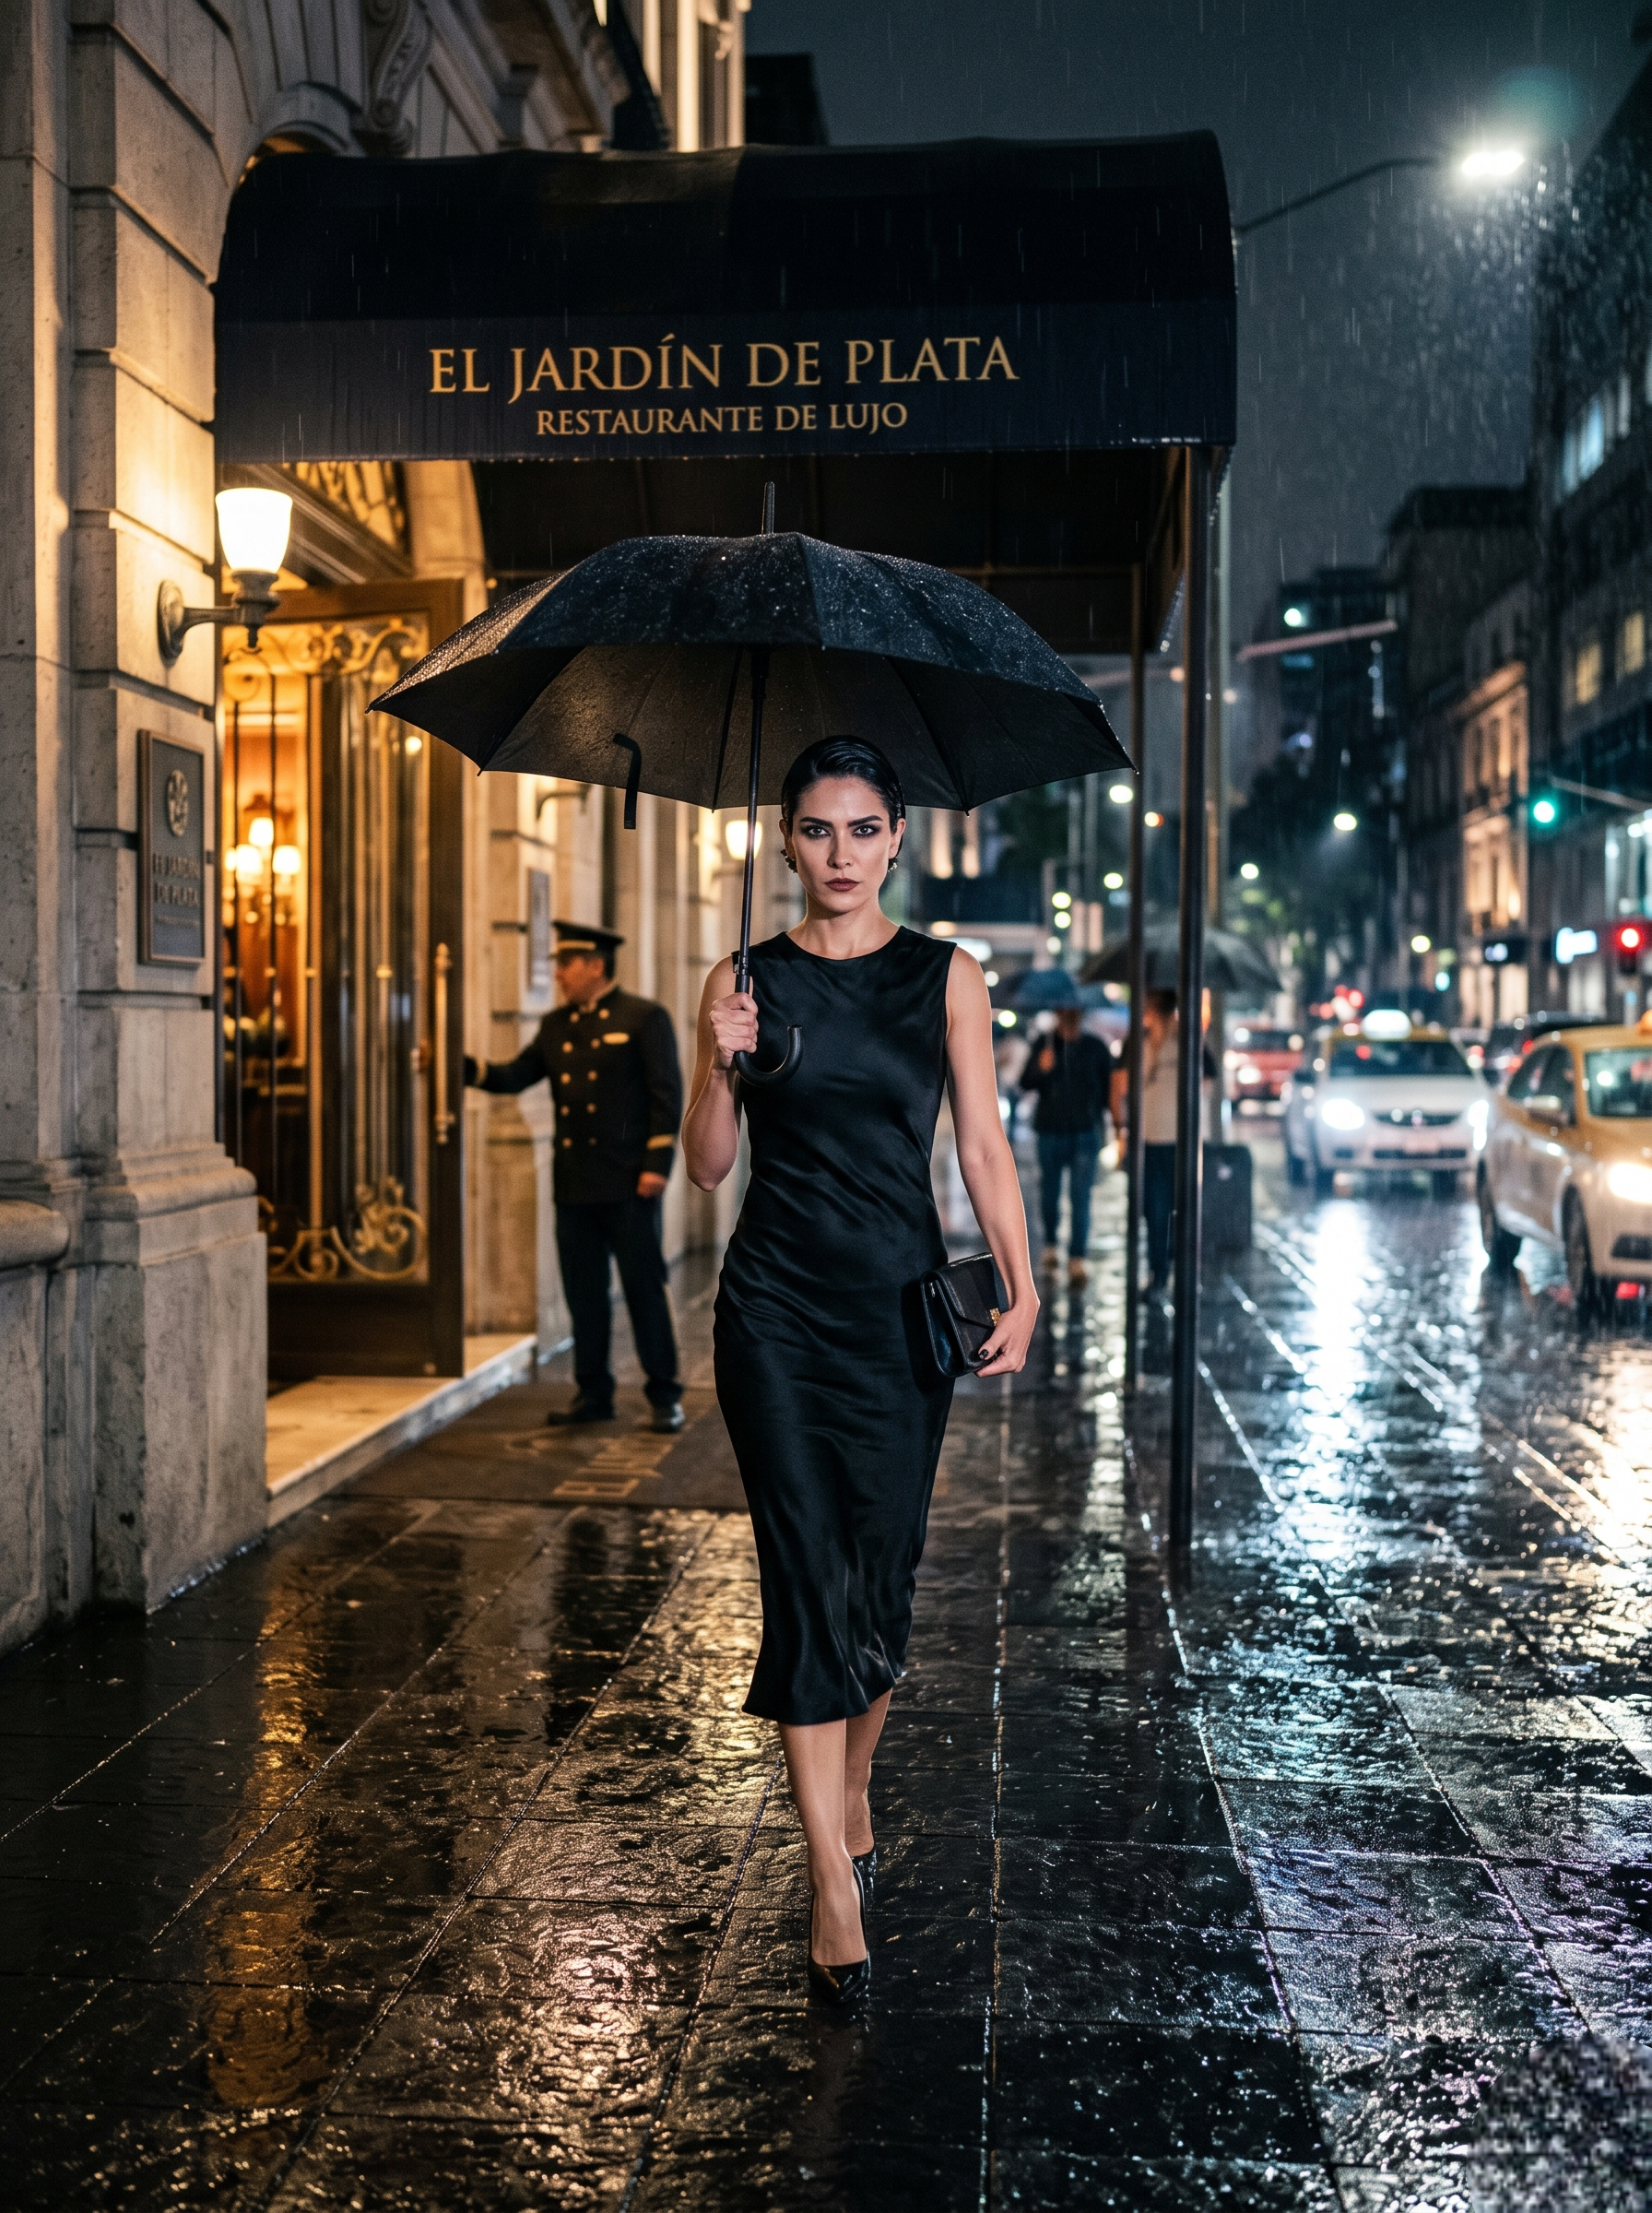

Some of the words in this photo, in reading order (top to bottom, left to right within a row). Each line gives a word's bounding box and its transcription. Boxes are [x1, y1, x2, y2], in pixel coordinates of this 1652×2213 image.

[430, 348, 490, 394] EL
[508, 333, 723, 405] JARDÍN
[747, 341, 821, 386] DE
[845, 336, 1021, 384] PLATA
[537, 407, 763, 435] RESTAURANTE
[775, 405, 817, 431] DE
[830, 402, 907, 434] LUJO
